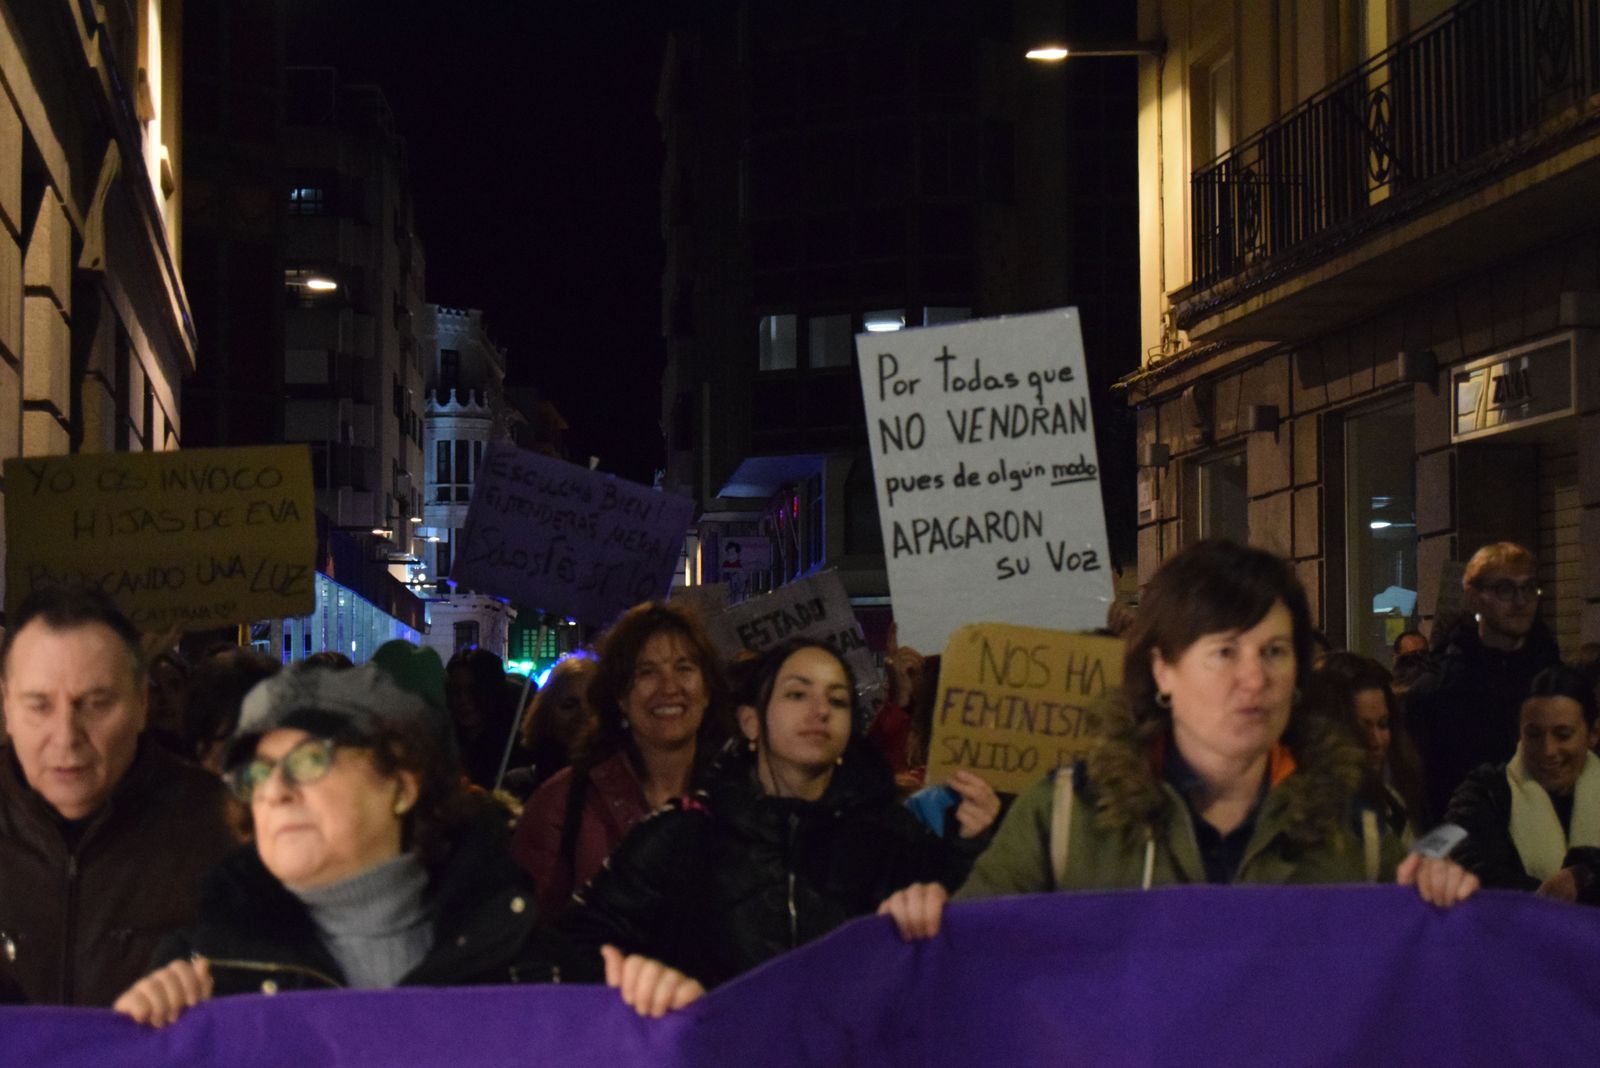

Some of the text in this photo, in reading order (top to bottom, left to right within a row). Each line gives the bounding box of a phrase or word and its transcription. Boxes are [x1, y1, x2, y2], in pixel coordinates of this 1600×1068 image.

[878, 354, 921, 401] Por
[1028, 366, 1075, 405] que
[879, 413, 926, 454] NO
[24, 462, 75, 496] YO
[160, 464, 283, 493] INVOCO
[886, 473, 945, 507] pues
[953, 462, 981, 487] de
[1052, 454, 1098, 479] modo
[73, 497, 301, 540] HIJAS DE EVA
[893, 510, 1043, 558] APAGARON
[197, 555, 247, 585] UNA
[250, 560, 309, 596] LUZ
[1065, 651, 1107, 698] HA
[940, 688, 1088, 739] FEMINIST
[941, 736, 1040, 773] SALIDO
